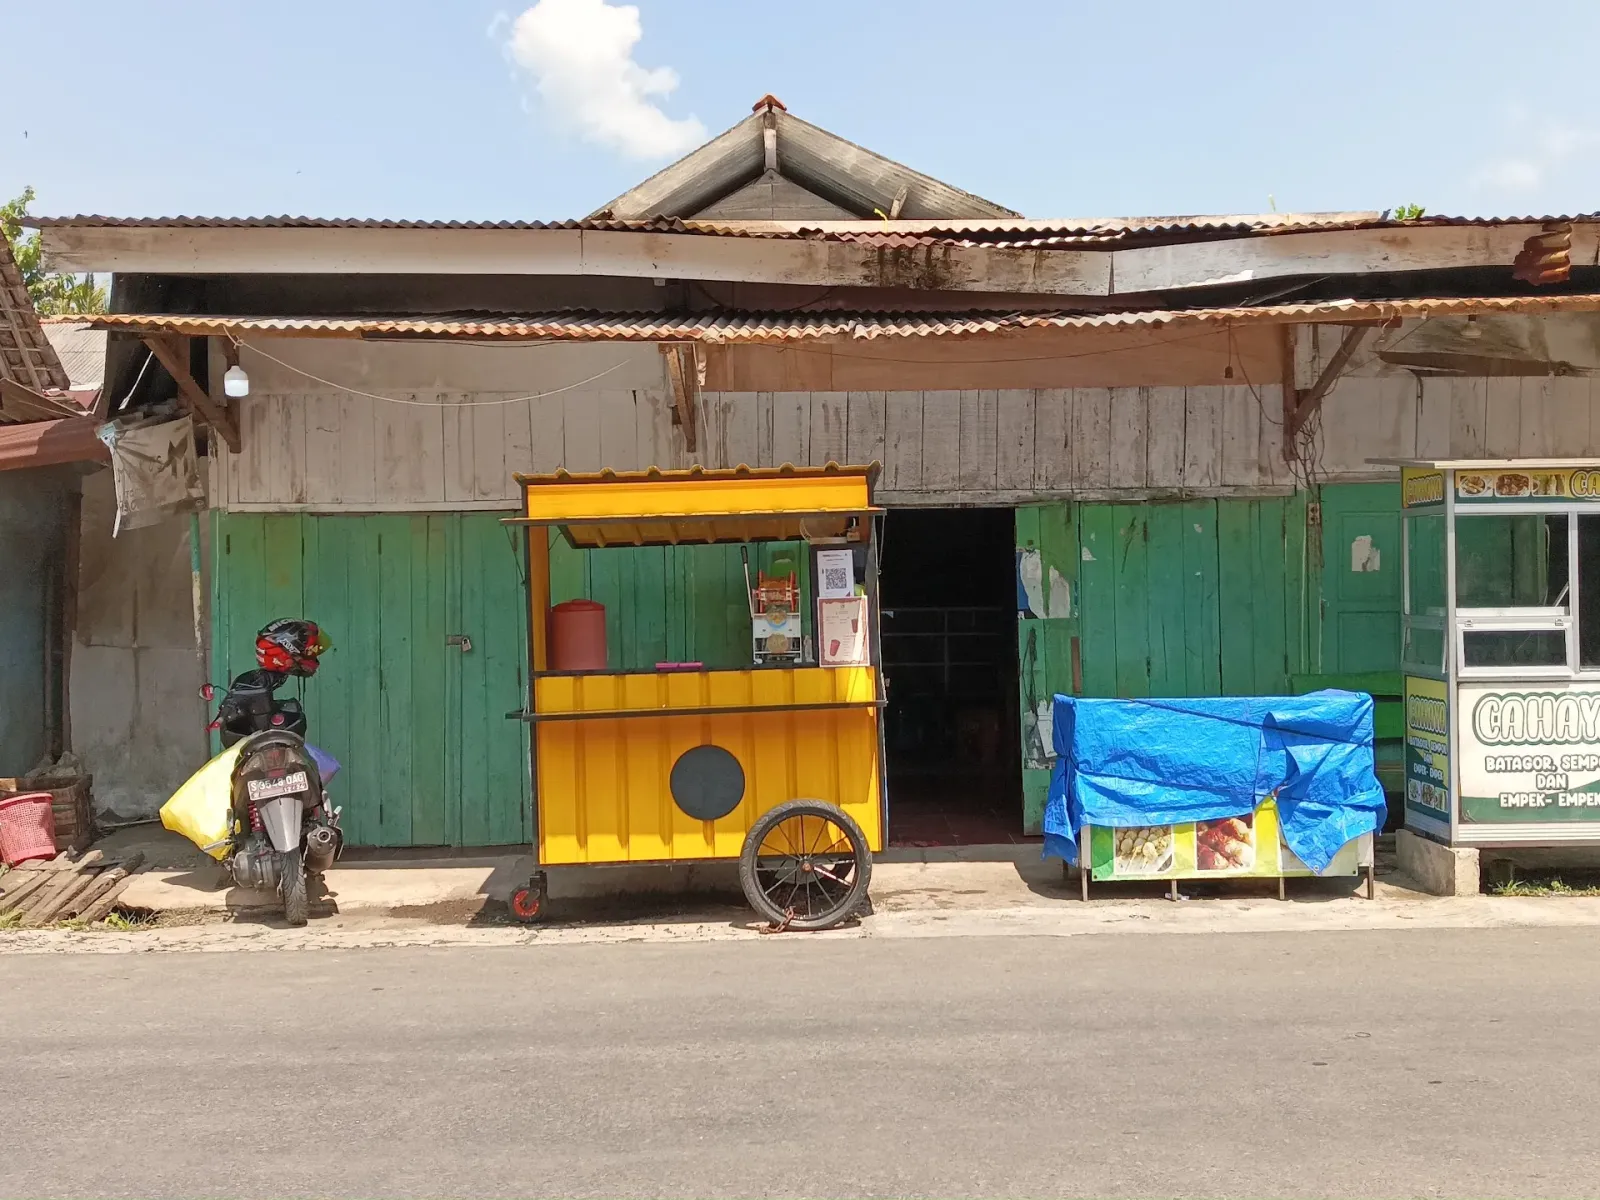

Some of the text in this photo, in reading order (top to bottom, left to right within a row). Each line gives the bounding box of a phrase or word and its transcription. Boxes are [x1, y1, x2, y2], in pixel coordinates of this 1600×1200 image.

[1570, 469, 1600, 498] CA
[1474, 694, 1600, 744] CAHAY
[1485, 754, 1600, 772] BATAGOR, SEMP
[250, 782, 257, 791] S
[259, 778, 284, 789] 3548
[1536, 773, 1568, 790] DAN
[1500, 793, 1553, 808] EMPEK-
